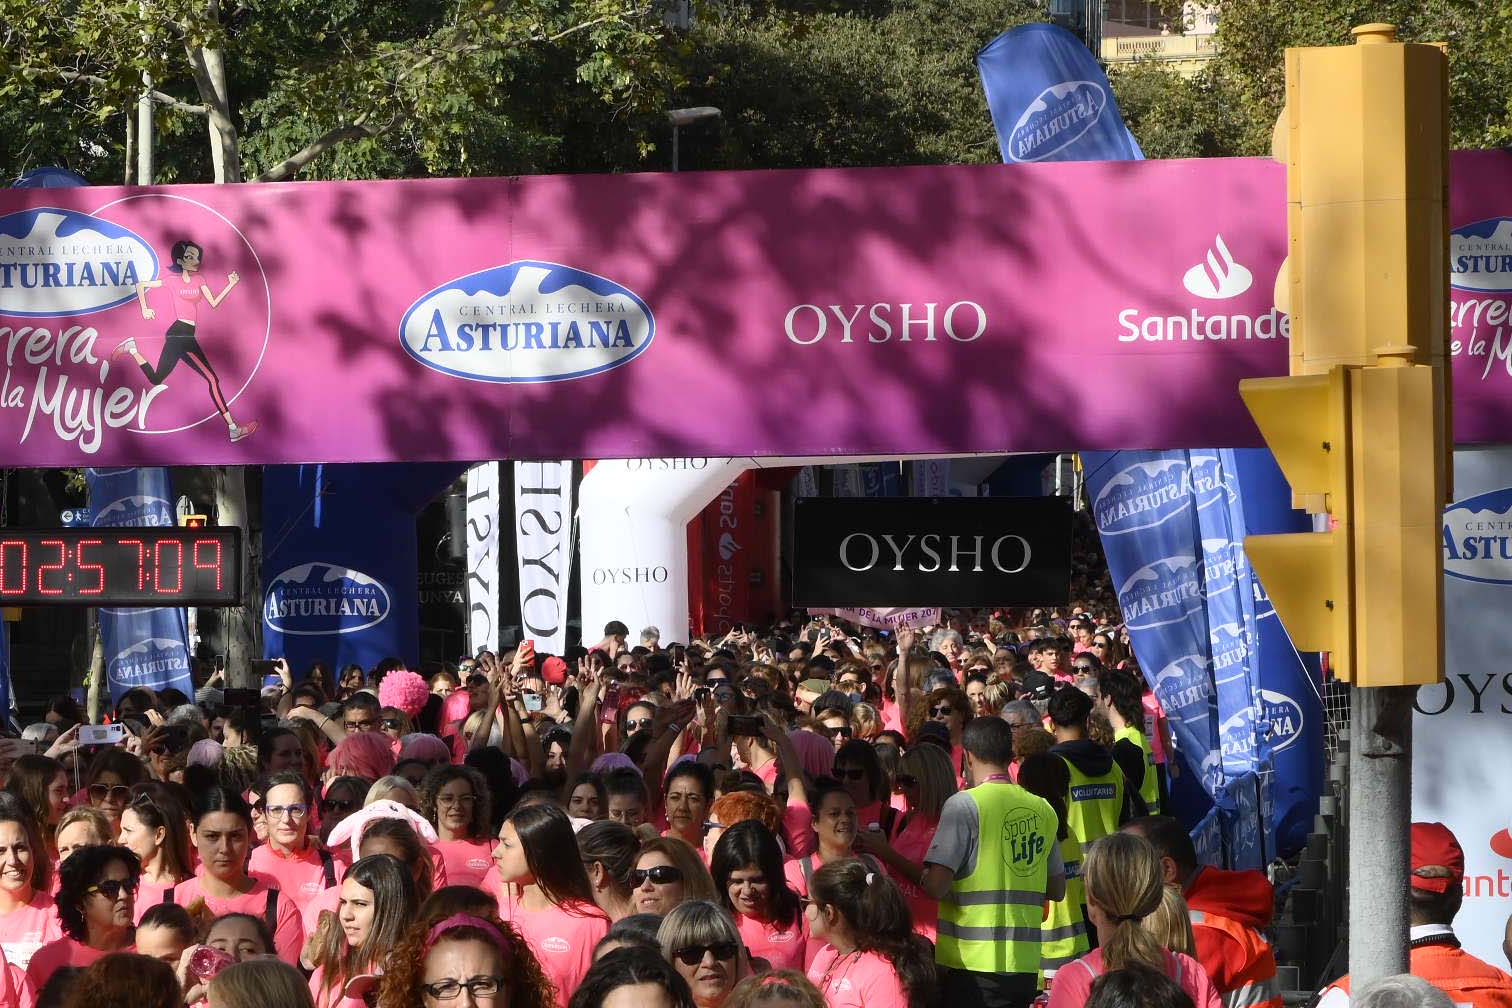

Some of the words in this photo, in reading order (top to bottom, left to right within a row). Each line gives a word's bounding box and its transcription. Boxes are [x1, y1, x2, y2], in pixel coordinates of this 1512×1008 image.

[61, 245, 135, 255] LECHERA
[459, 303, 537, 316] CENTRAL
[546, 301, 627, 313] LECHERA
[784, 301, 987, 345] OYSHO
[1117, 306, 1291, 343] Santande
[419, 308, 635, 352] ASTURIANA
[1, 369, 25, 408] la
[20, 360, 169, 454] Mujer
[0, 539, 221, 595] 02:57:09
[839, 532, 1032, 574] OYSHO
[592, 565, 669, 586] OYSHO
[268, 591, 381, 619] ASTURIANA
[1004, 813, 1039, 840] Sport
[1011, 831, 1045, 865] Life
